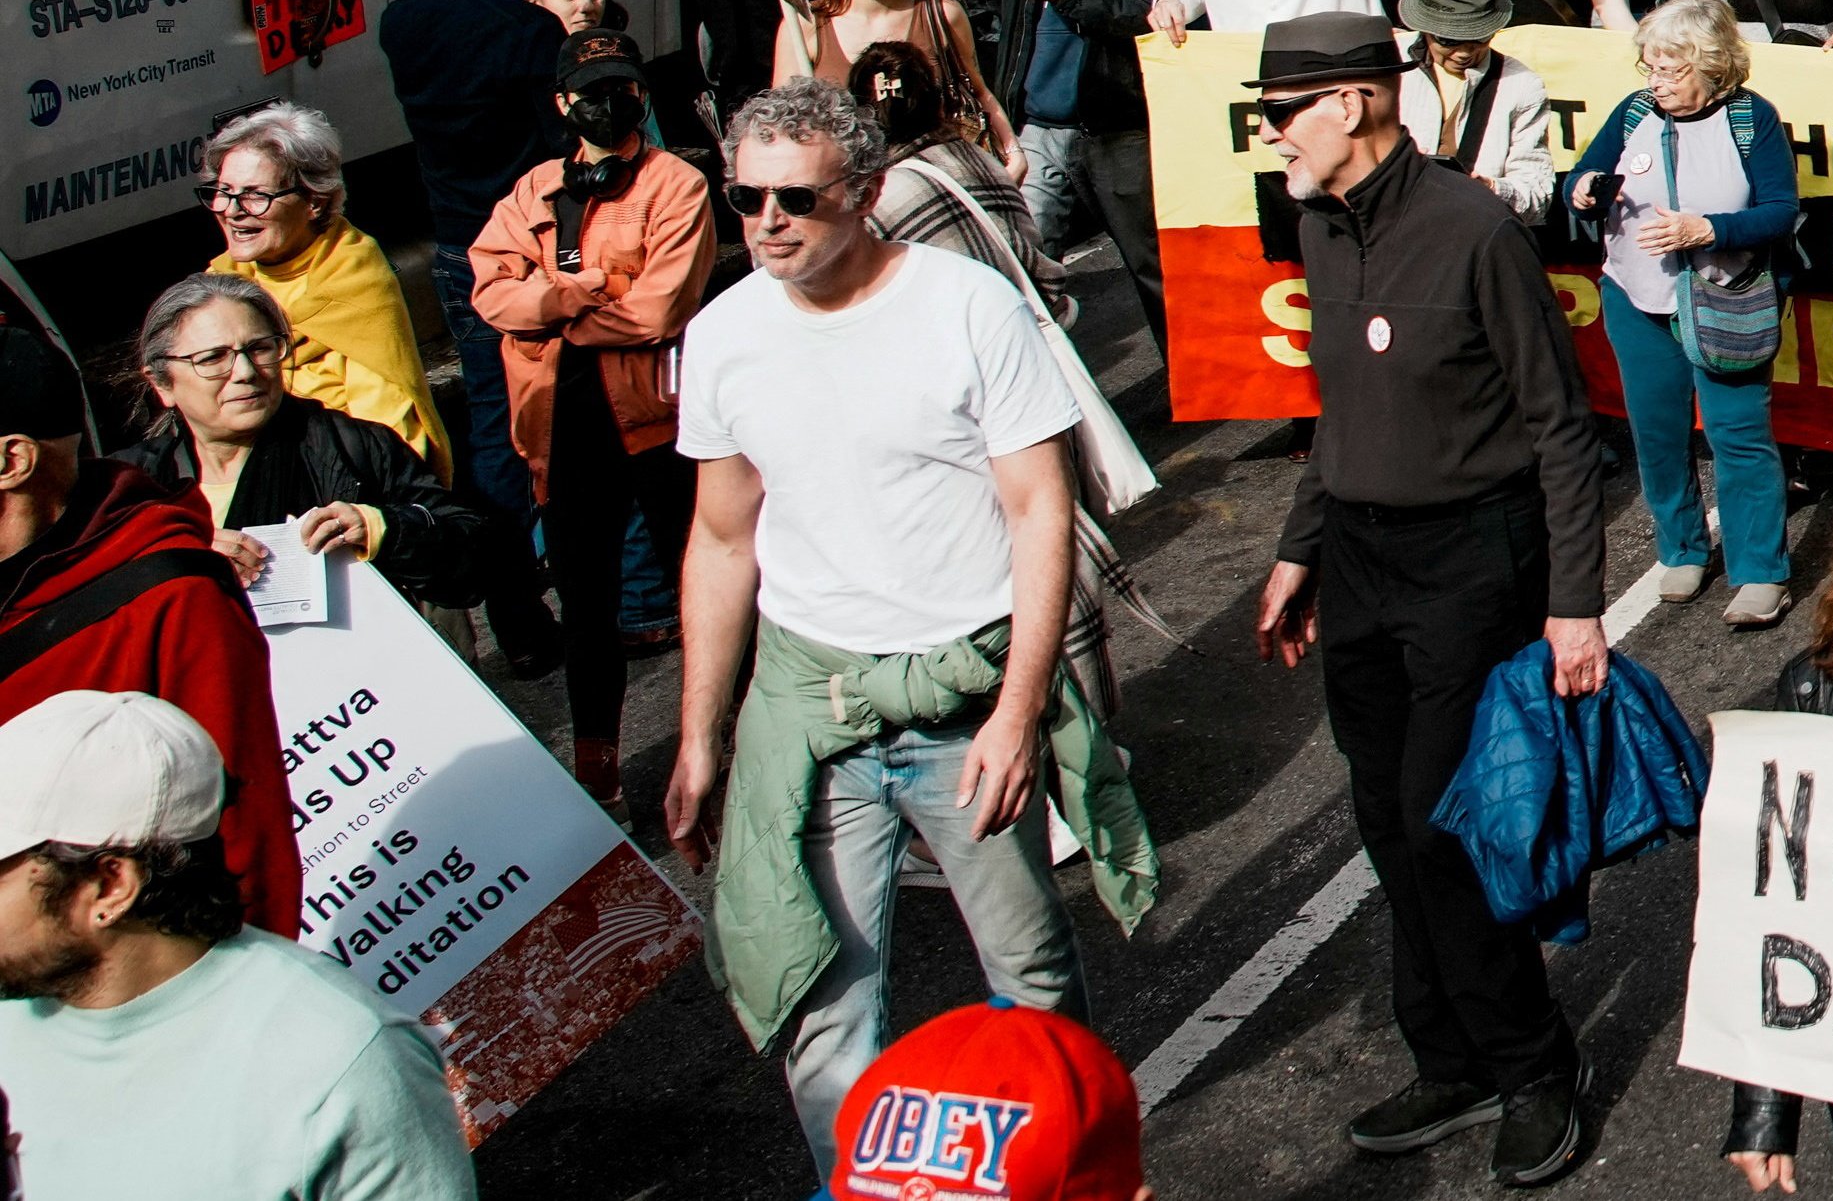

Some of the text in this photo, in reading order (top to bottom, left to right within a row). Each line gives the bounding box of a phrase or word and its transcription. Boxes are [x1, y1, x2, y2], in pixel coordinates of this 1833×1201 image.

[28, 49, 217, 119] MTA New York City Transit
[25, 134, 214, 225] MAINTENANC
[280, 685, 380, 776] attva
[328, 734, 398, 786] Up
[300, 764, 428, 876] shion to Street
[371, 828, 419, 867] is
[376, 861, 531, 996] ditation
[852, 1085, 1034, 1192] OBEY
